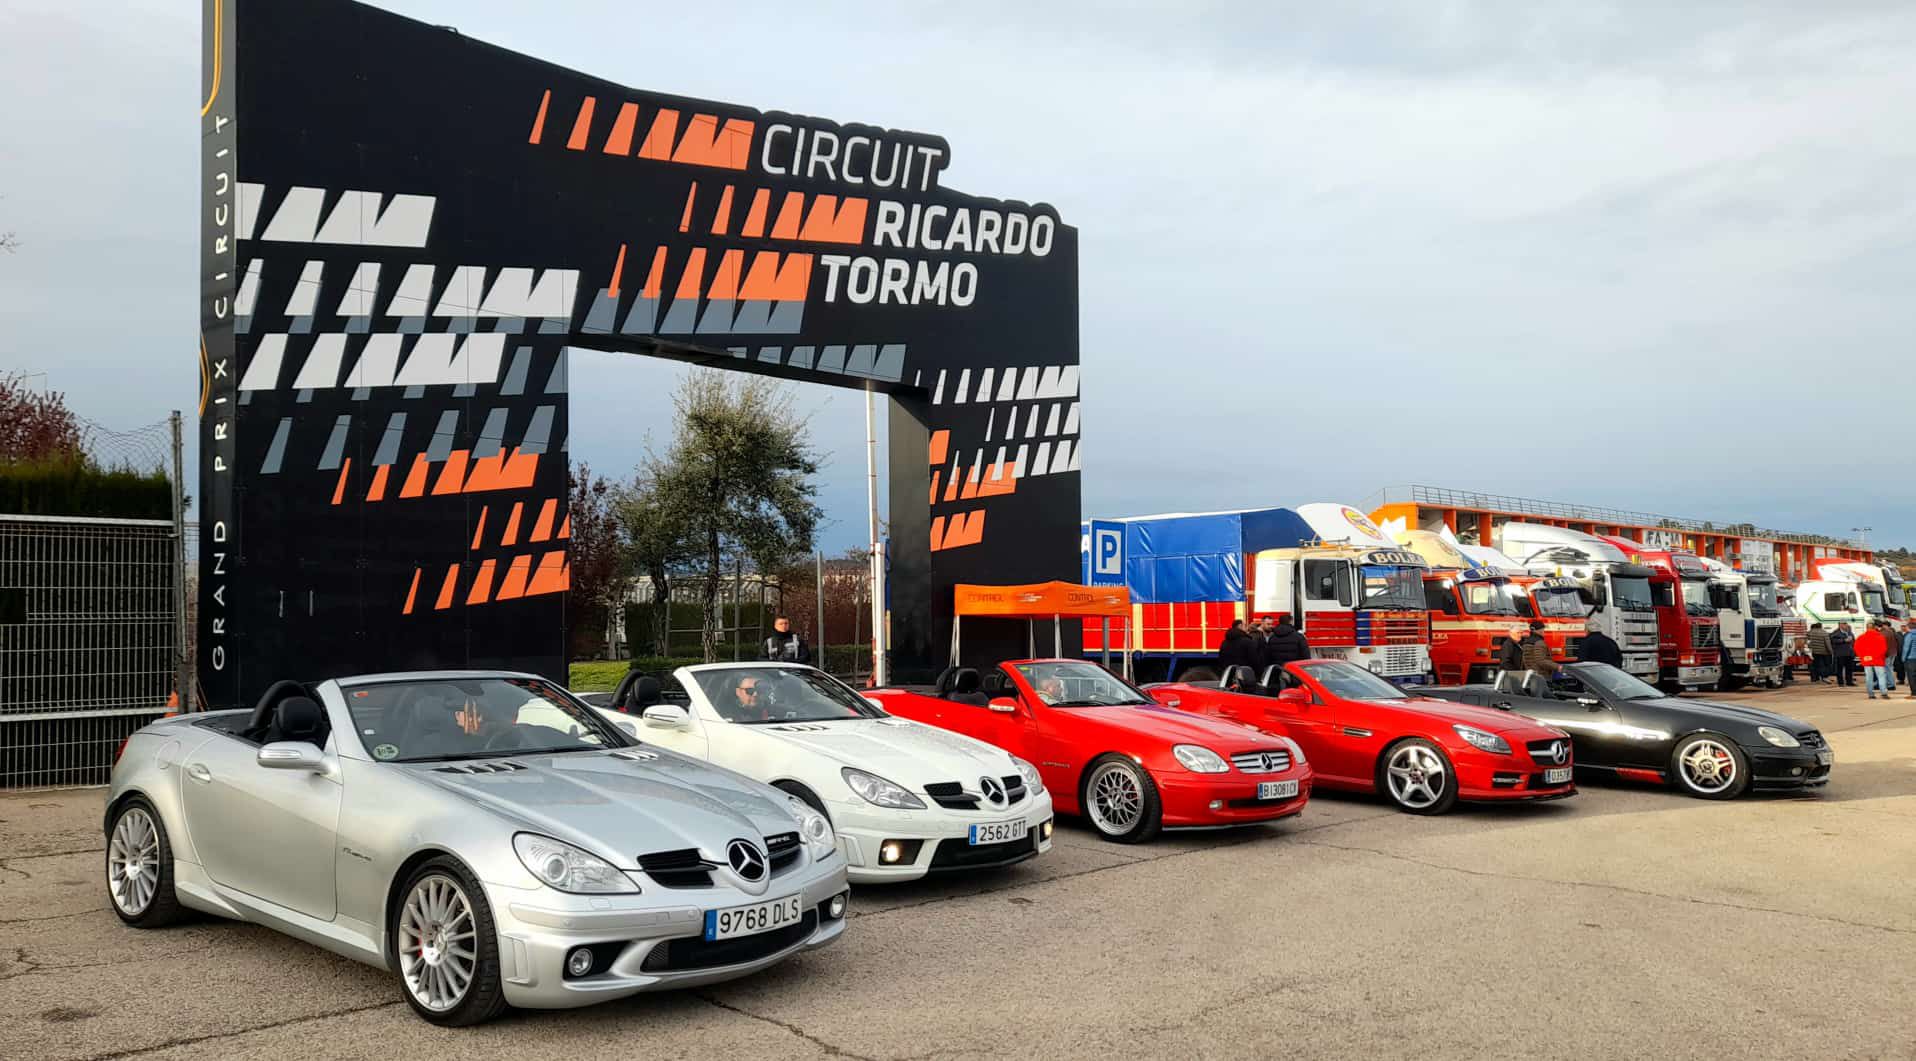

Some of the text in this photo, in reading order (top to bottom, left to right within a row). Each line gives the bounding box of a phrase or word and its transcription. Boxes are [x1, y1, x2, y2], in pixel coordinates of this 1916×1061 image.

[761, 124, 942, 192] CIRCUIT
[873, 200, 1055, 256] RICARDO
[820, 254, 978, 307] TORMO
[213, 115, 229, 670] GRAND PRIX CIRCUIT
[1102, 534, 1118, 569] P
[979, 824, 1010, 842] 2562
[719, 899, 799, 934] 9768 DLS
